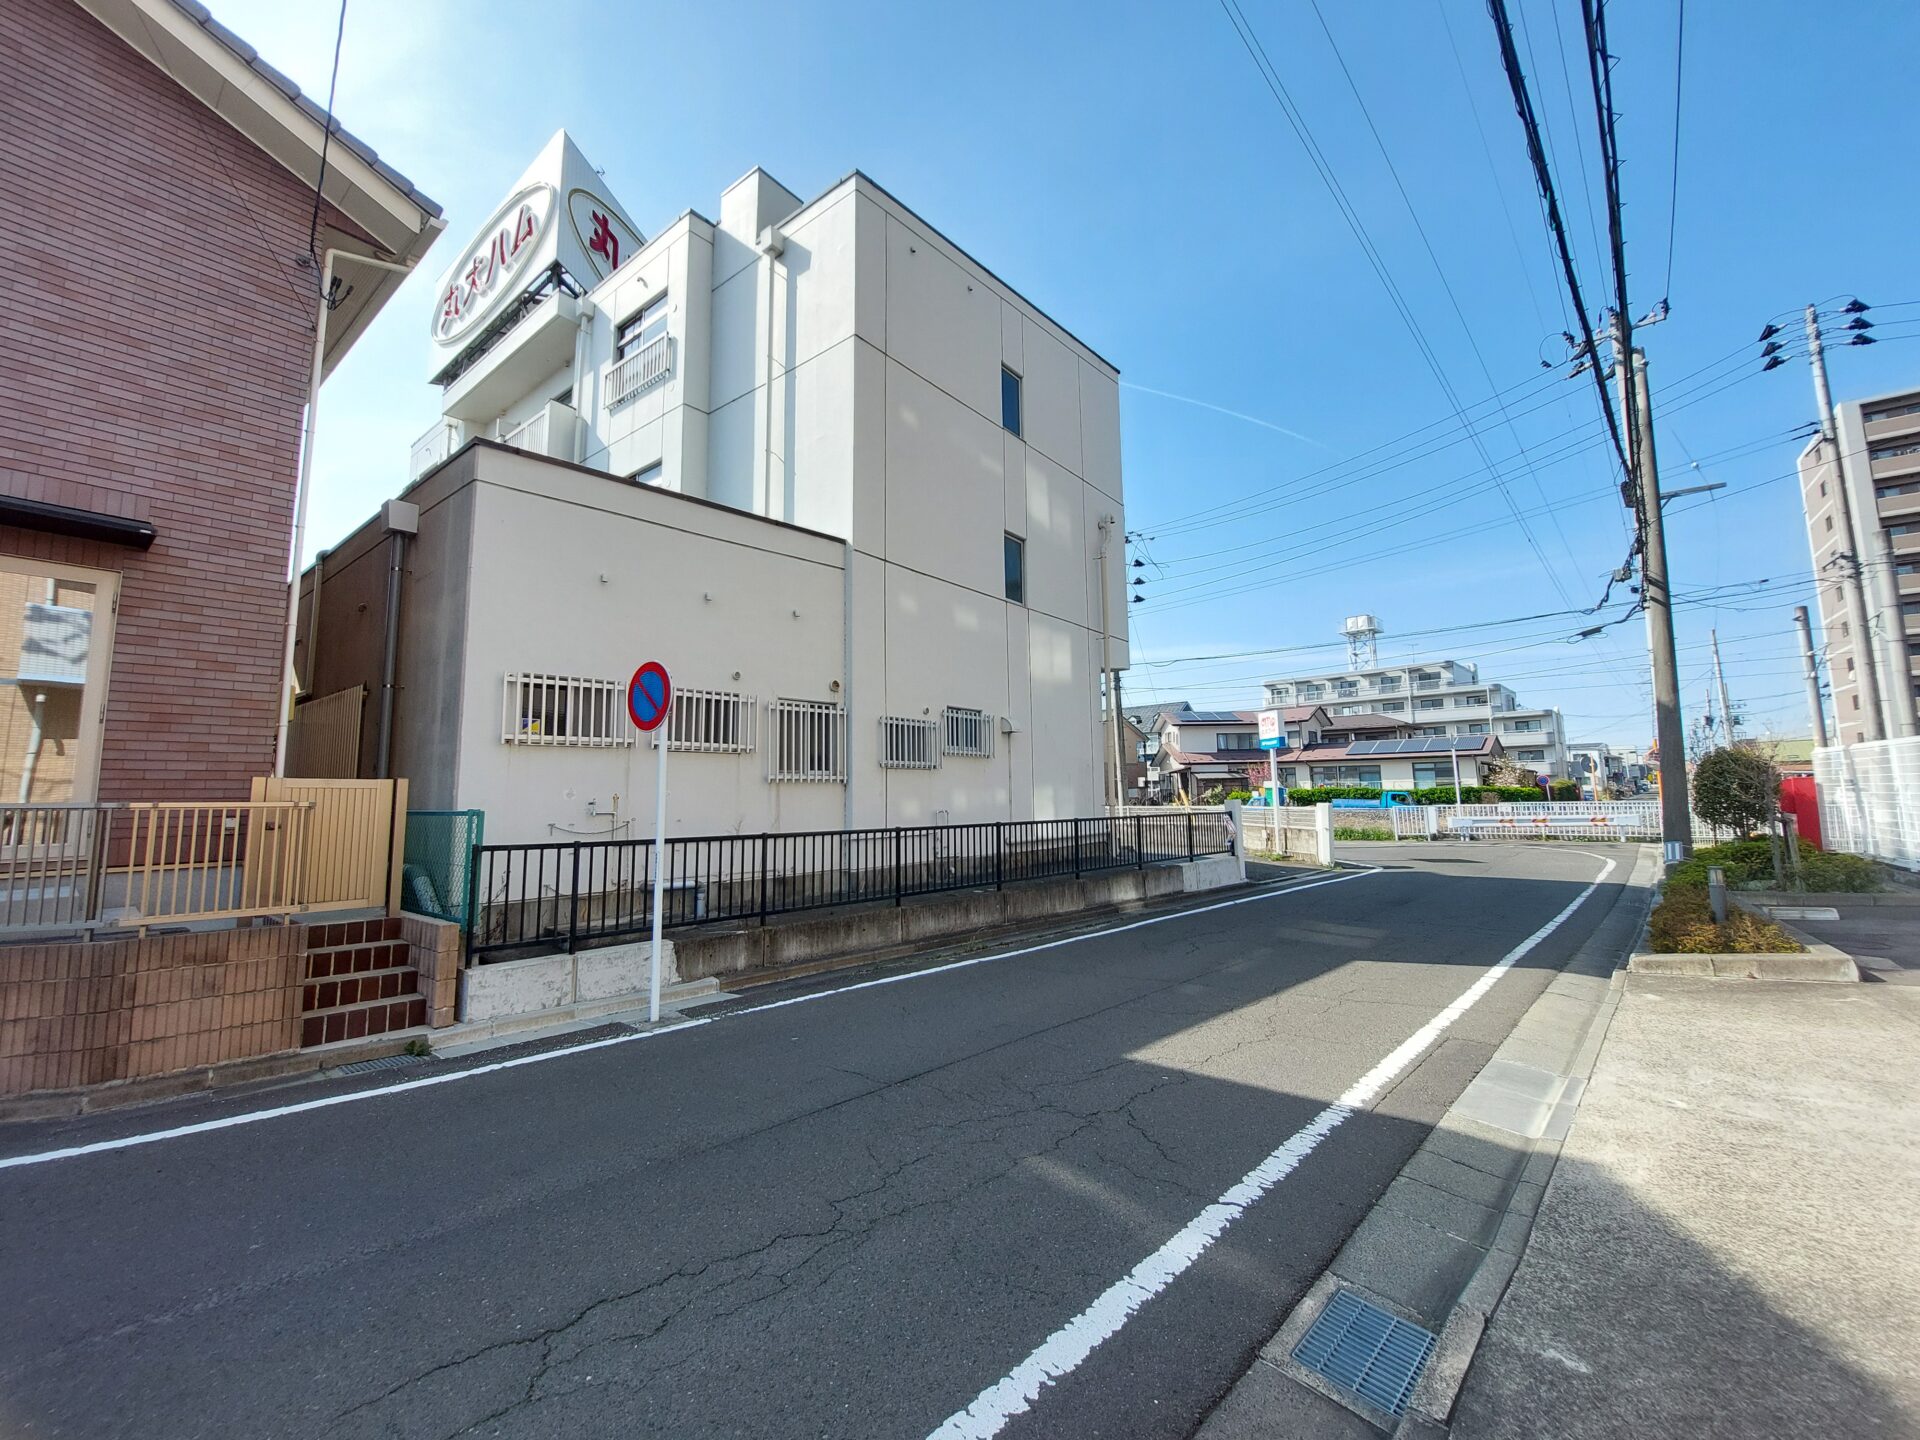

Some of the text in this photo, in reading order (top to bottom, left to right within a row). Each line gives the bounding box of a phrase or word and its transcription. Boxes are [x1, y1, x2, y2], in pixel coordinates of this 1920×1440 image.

[441, 204, 535, 332] 丸大ハム
[589, 209, 630, 271] 丸
